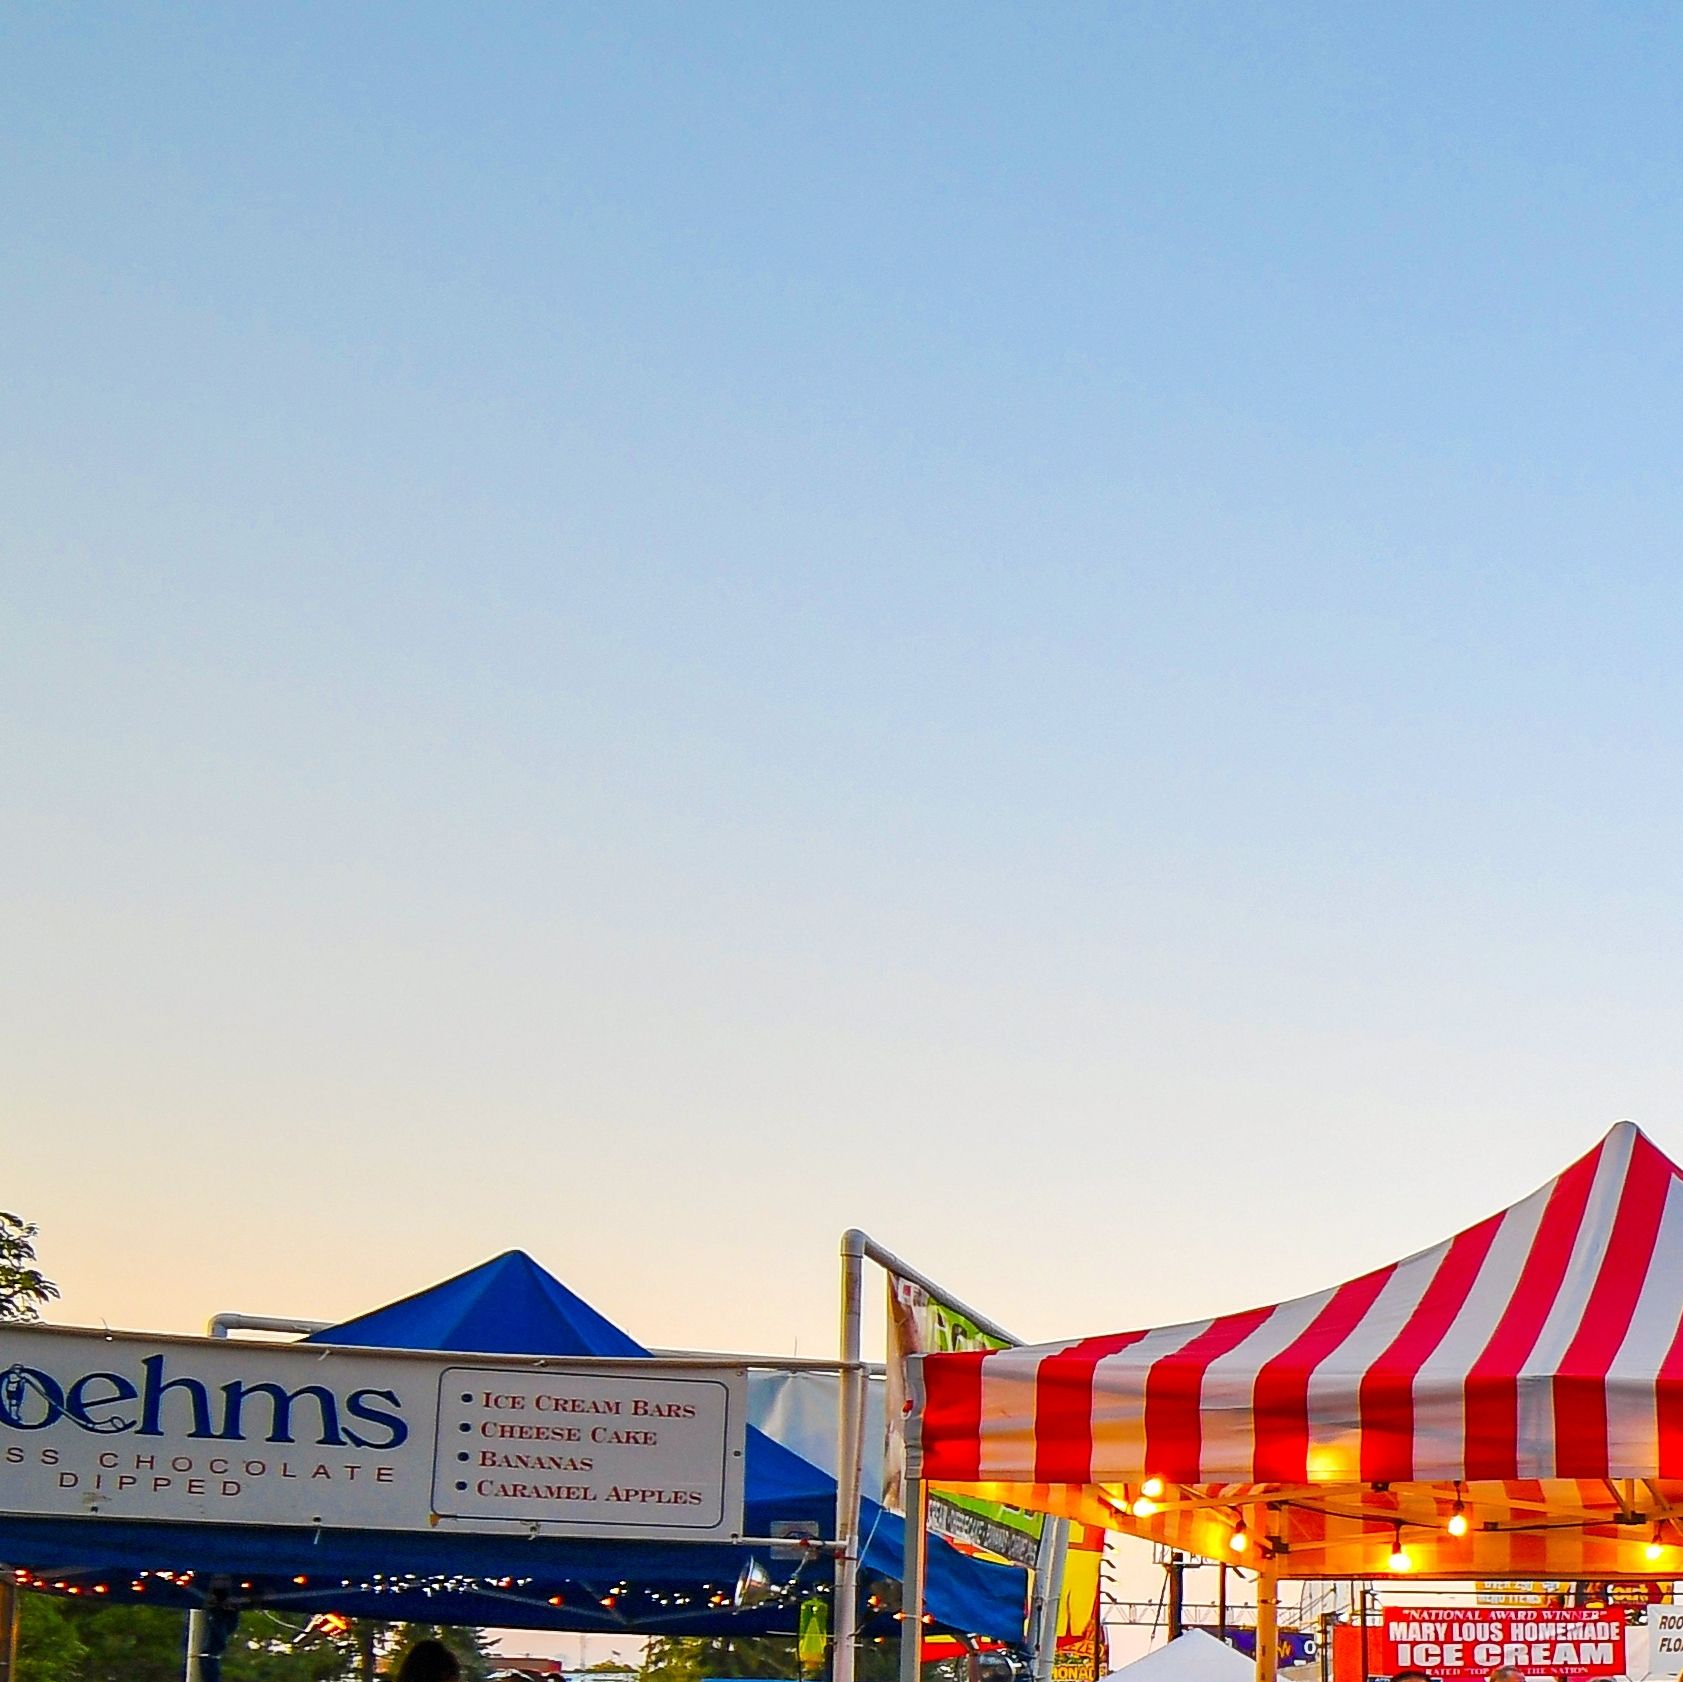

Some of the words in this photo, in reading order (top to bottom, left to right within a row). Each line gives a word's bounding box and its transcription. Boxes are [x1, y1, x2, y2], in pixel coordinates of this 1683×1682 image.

[483, 1392, 525, 1409] ICE
[535, 1395, 621, 1415] CREAM
[631, 1399, 696, 1418] BARS
[480, 1422, 581, 1442] CHEESE
[590, 1427, 657, 1446] CAKE
[98, 1451, 394, 1483] CHOCOLATE
[478, 1450, 594, 1472] BANANAS
[59, 1471, 242, 1497] DIPPED
[477, 1479, 597, 1501] CARAMEL
[604, 1486, 702, 1505] APPLES
[1488, 1610, 1537, 1620] AWARD
[1389, 1622, 1447, 1642] MARY
[1452, 1622, 1504, 1642] LOUS
[1510, 1621, 1621, 1642] HOMEMADE
[1397, 1643, 1464, 1667] ICE
[1474, 1642, 1614, 1667] CREAM
